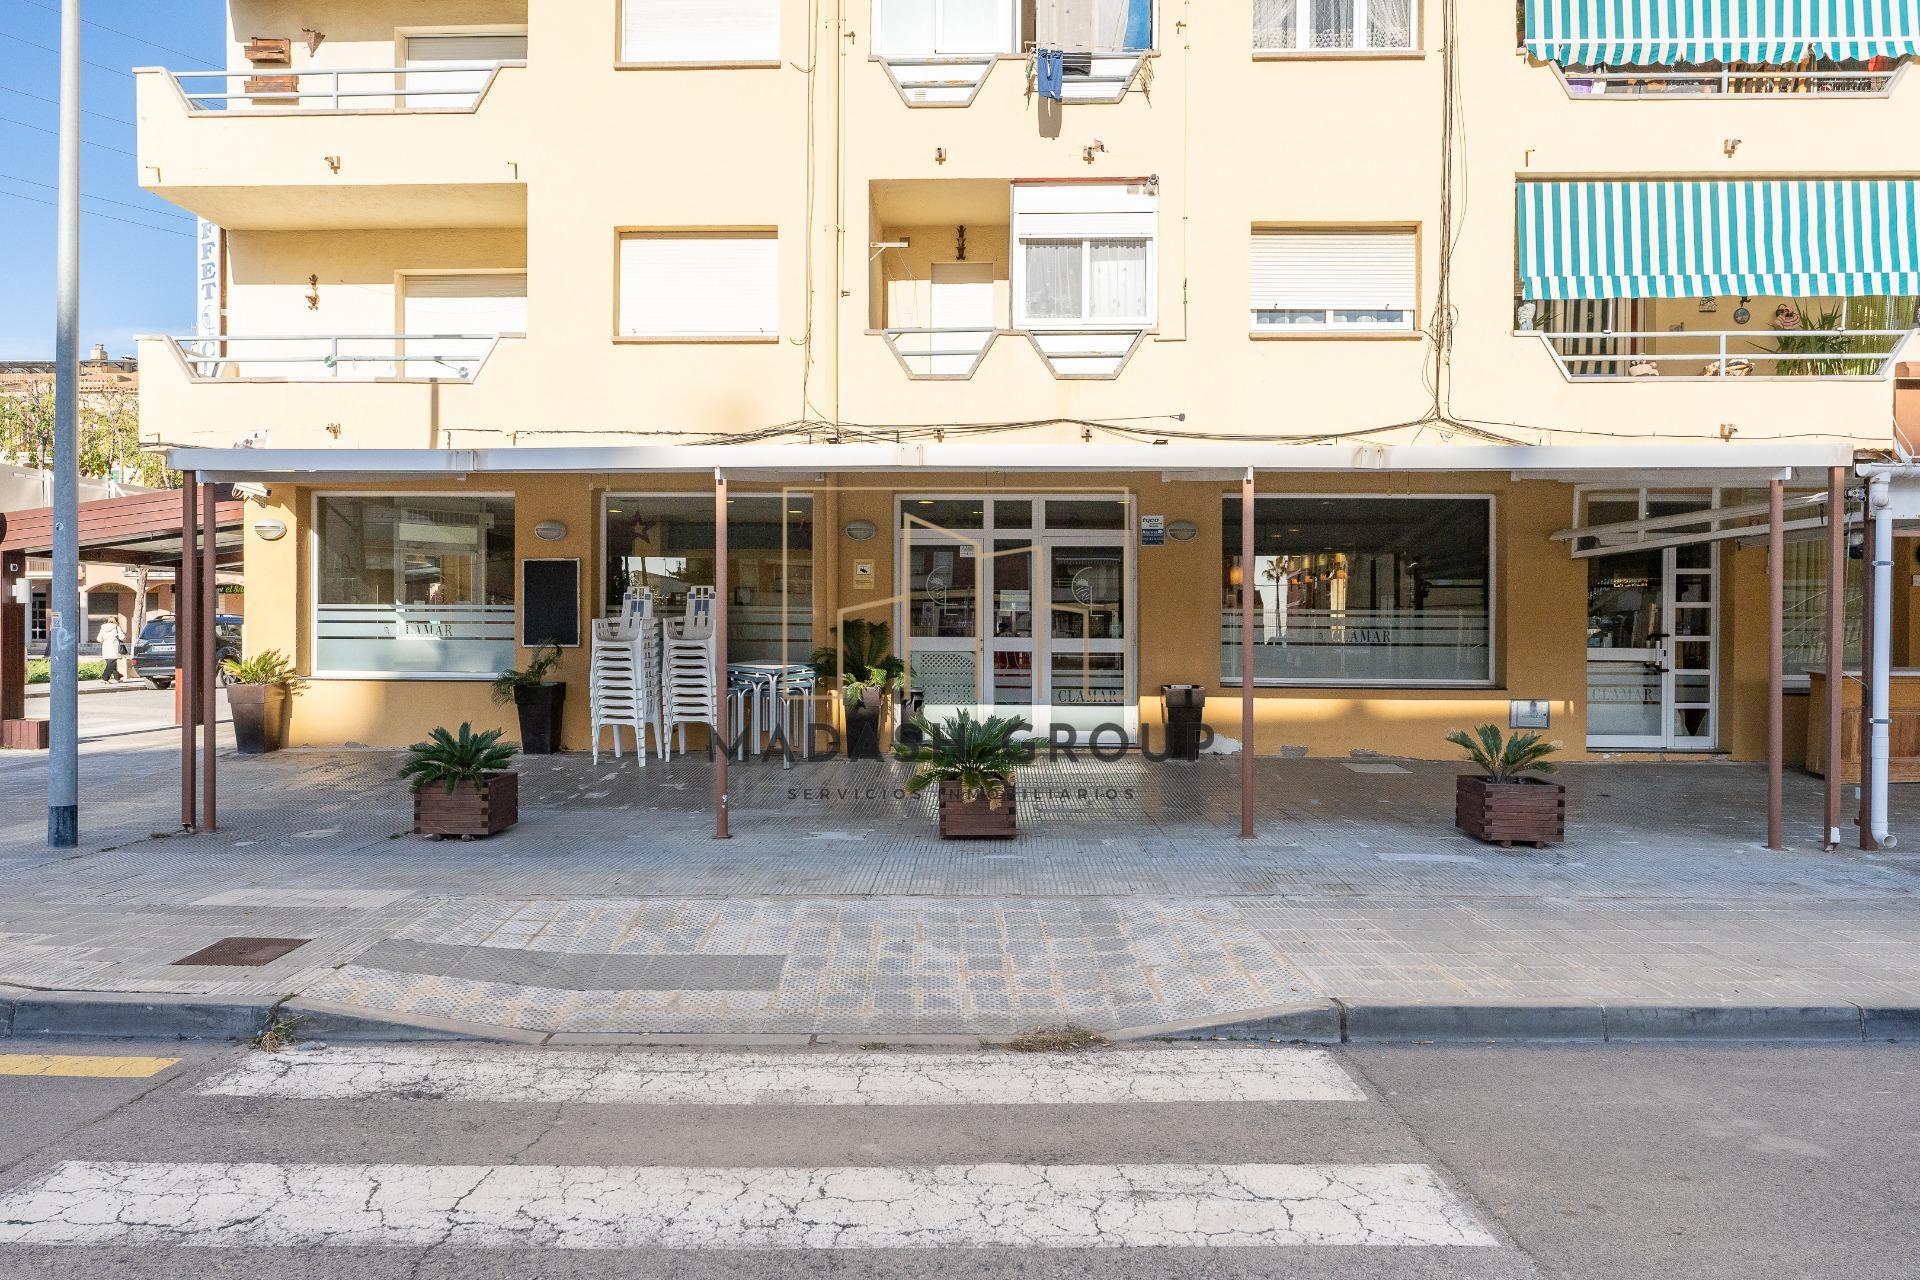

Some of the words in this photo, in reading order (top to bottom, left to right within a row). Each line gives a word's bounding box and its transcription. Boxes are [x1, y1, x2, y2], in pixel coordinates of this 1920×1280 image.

[1331, 629, 1391, 643] CLAMAR
[1058, 689, 1117, 703] CLAMAR
[1592, 687, 1653, 701] CLAMAR
